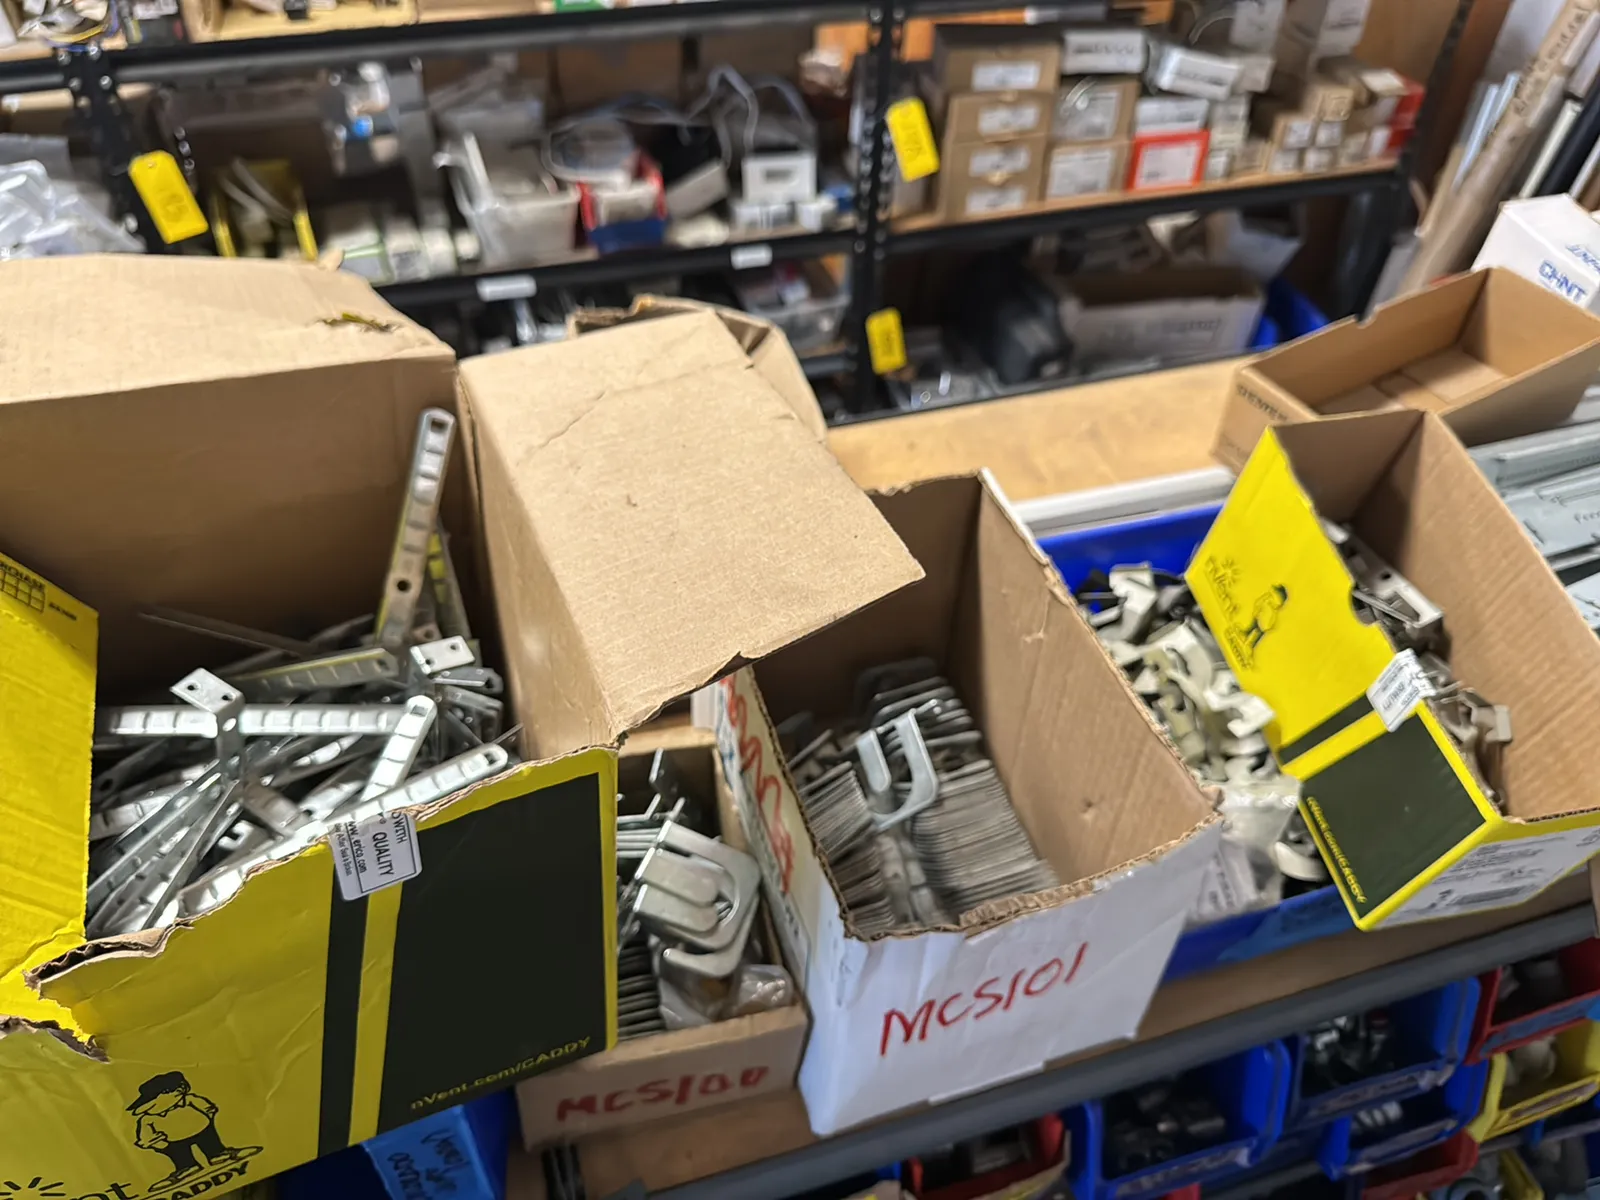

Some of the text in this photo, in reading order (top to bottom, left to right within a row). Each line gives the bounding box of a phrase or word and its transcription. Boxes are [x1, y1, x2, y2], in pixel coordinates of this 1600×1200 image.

[372, 831, 395, 876] QUALITY
[393, 820, 408, 845] WITH
[879, 942, 1088, 1056] MCS101
[410, 1036, 591, 1110] nVent.com/CADDY
[557, 1066, 769, 1120] MCS100
